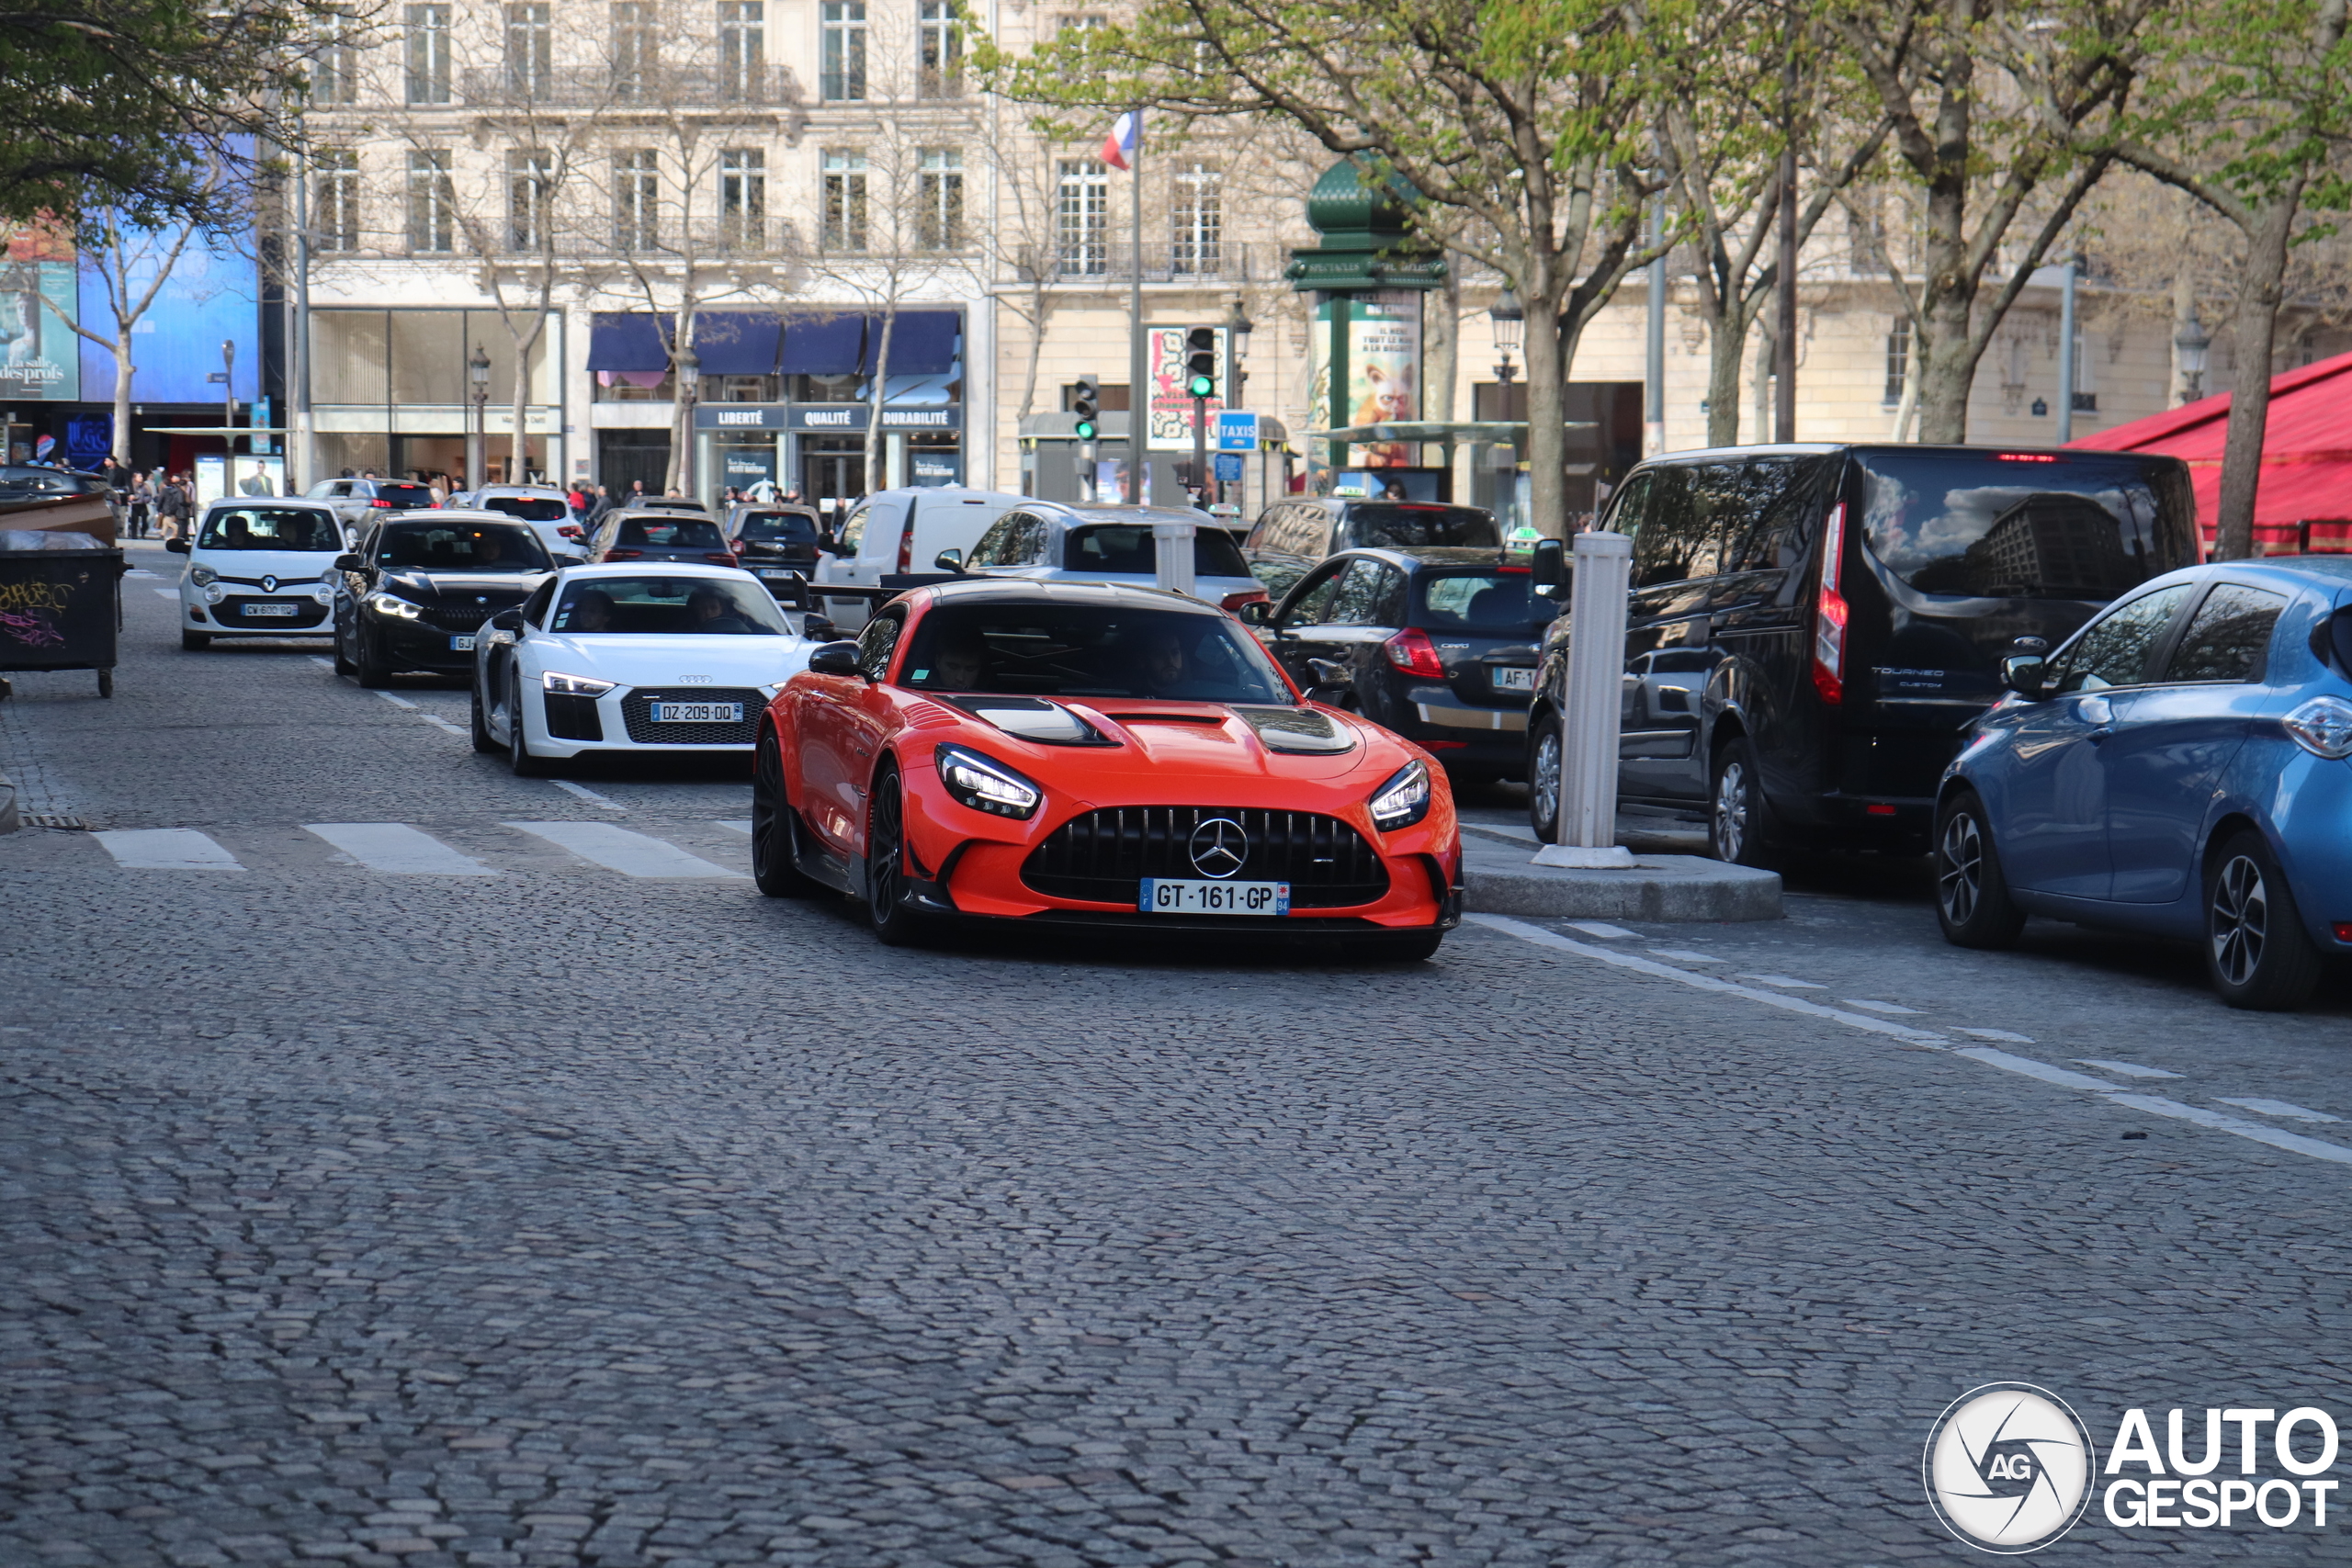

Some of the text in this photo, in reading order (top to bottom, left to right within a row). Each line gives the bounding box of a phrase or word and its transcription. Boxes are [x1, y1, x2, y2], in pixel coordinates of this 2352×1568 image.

[26, 355, 52, 367] salle
[718, 410, 763, 424] LIBERTÉ
[805, 410, 852, 426] QUALITÉ
[883, 410, 948, 425] DURABILITÉ
[1221, 425, 1256, 437] TAXIS
[1871, 667, 1944, 677] TOURNEO
[663, 705, 730, 719] DZ-209-DQ
[1158, 885, 1272, 909] GT-161-GP
[1278, 900, 1287, 911] 94
